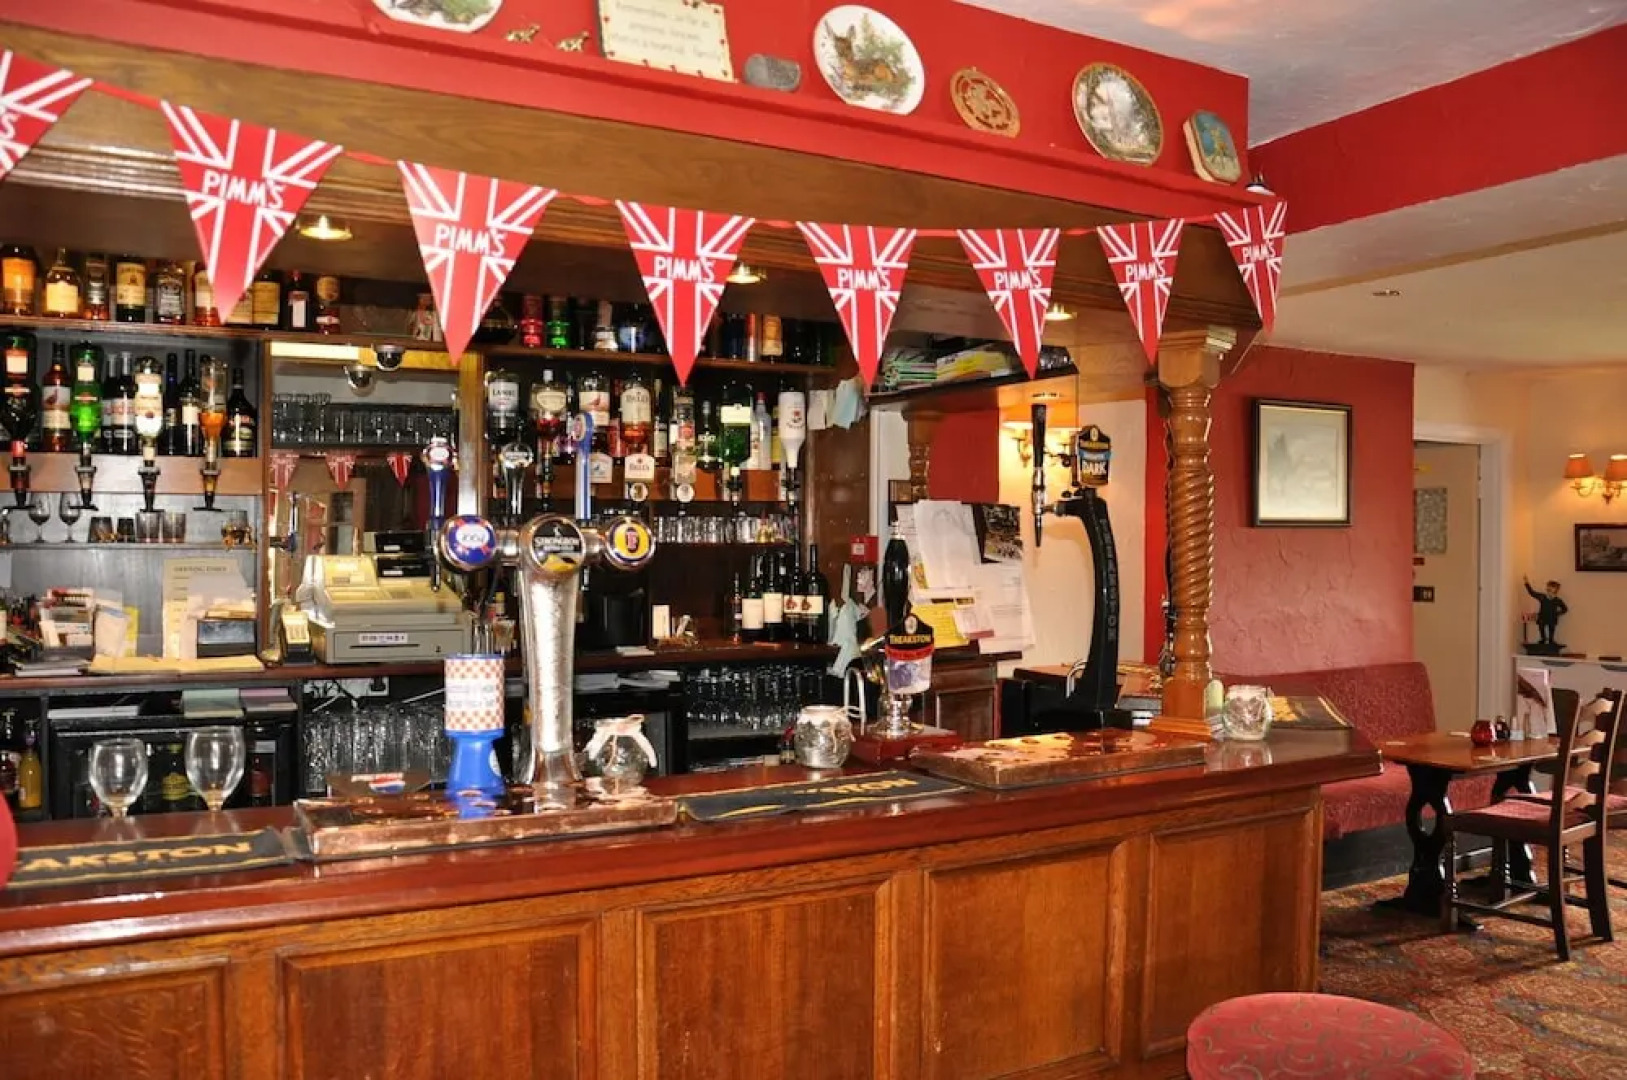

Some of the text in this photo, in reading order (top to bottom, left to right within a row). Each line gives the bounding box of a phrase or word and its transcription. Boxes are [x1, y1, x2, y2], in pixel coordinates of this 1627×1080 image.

[202, 169, 284, 209] PIMM'S
[435, 223, 505, 257] PIMM'S
[1243, 238, 1276, 262] PIMM'S
[654, 255, 715, 283] PIMM'S
[837, 265, 890, 290] PIMM'S
[993, 266, 1041, 290] PIMM'S
[1125, 257, 1165, 283] PIMM'S
[1081, 460, 1107, 475] DARK
[20, 841, 252, 872] AKSTON
